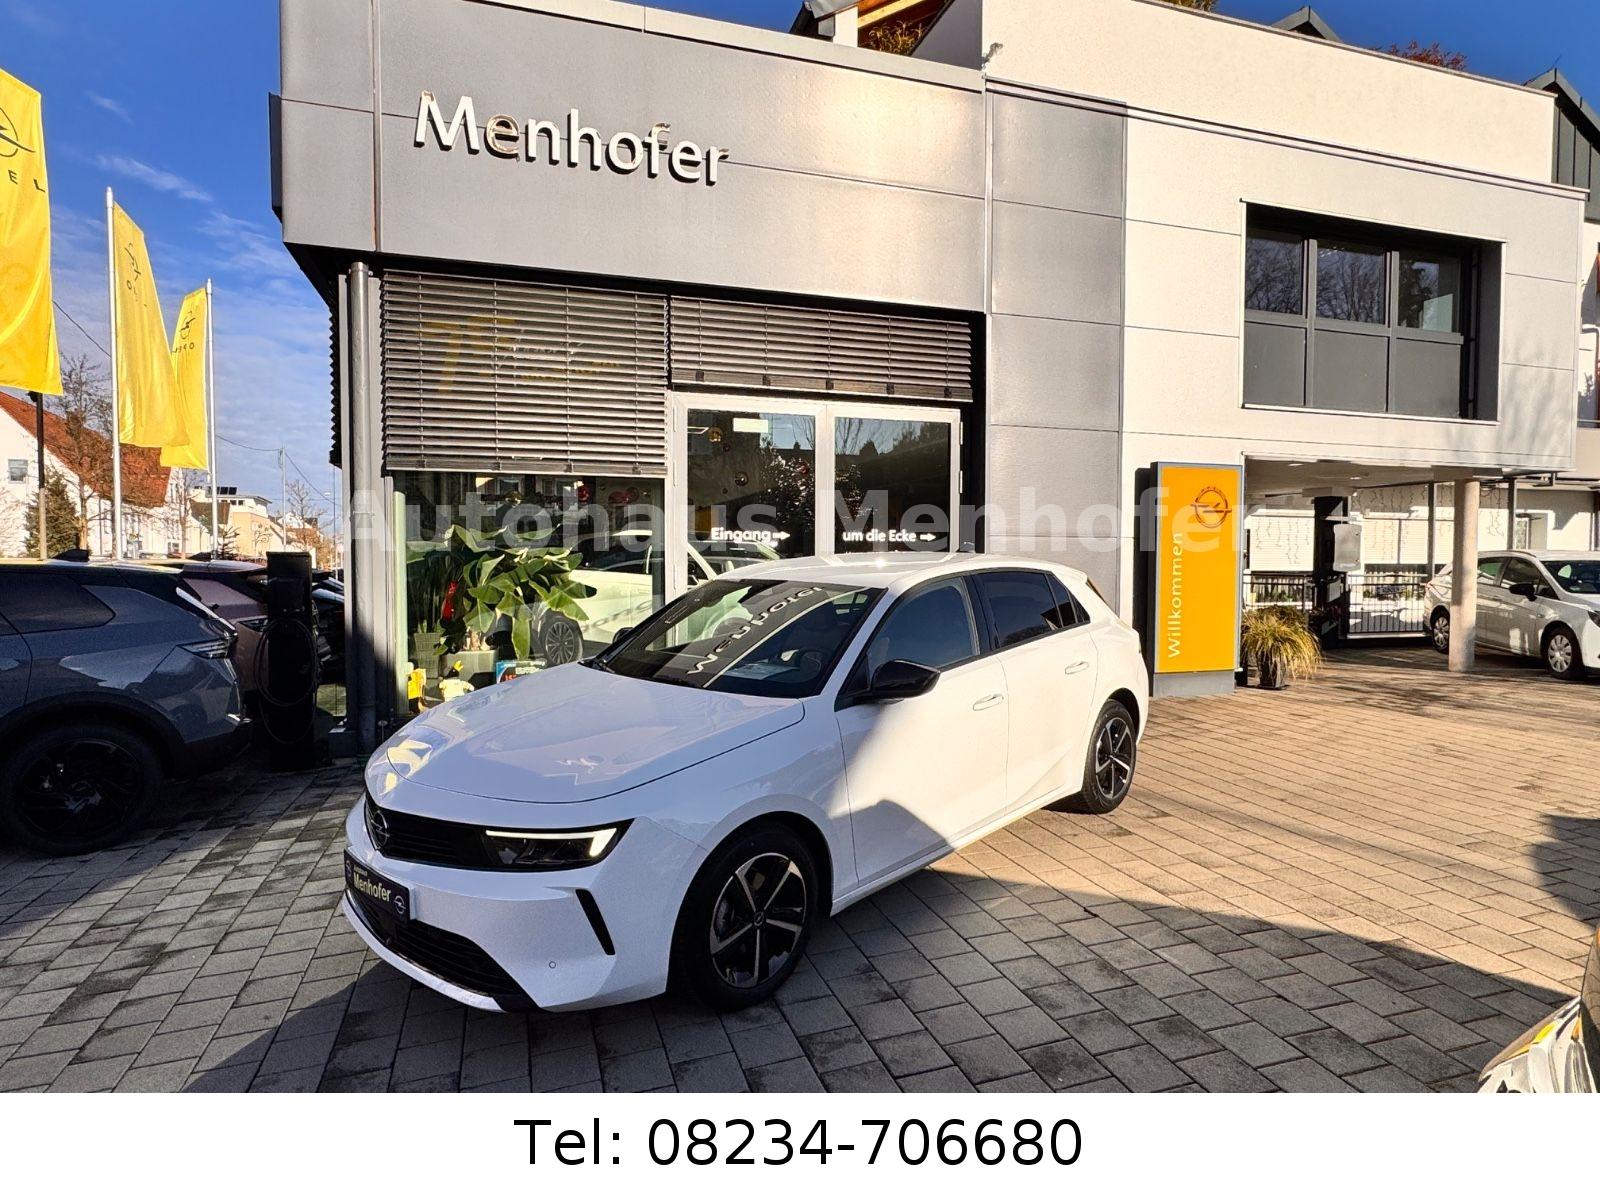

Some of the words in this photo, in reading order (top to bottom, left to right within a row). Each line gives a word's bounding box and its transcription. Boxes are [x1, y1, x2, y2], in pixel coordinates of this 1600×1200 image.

[415, 90, 729, 187] Menhofer
[710, 527, 772, 543] Eingang
[842, 531, 865, 542] um
[865, 529, 886, 543] die
[888, 529, 917, 543] Ecke
[1167, 531, 1183, 658] Willkommen
[353, 871, 391, 902] Menhofer
